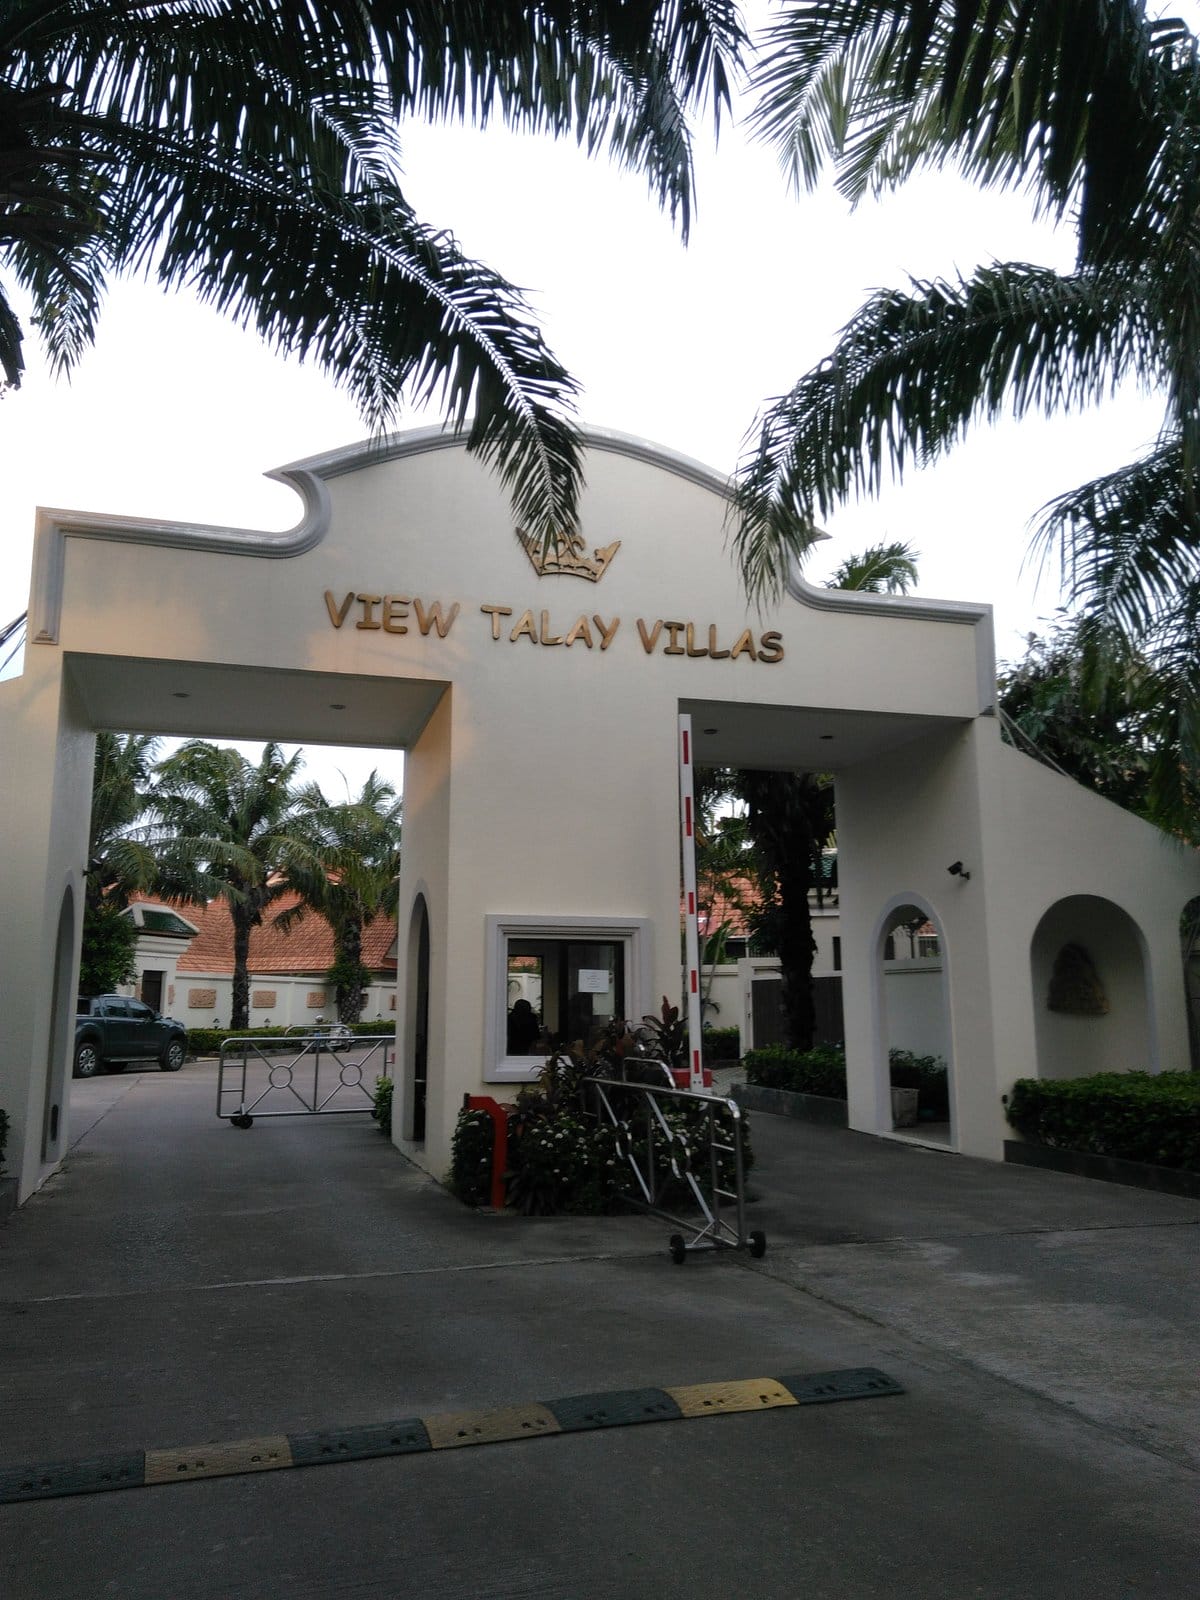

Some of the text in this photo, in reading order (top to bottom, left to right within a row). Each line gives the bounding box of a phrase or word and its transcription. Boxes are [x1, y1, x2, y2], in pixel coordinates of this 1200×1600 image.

[325, 590, 784, 663] VIEW TALAY VILLAS
